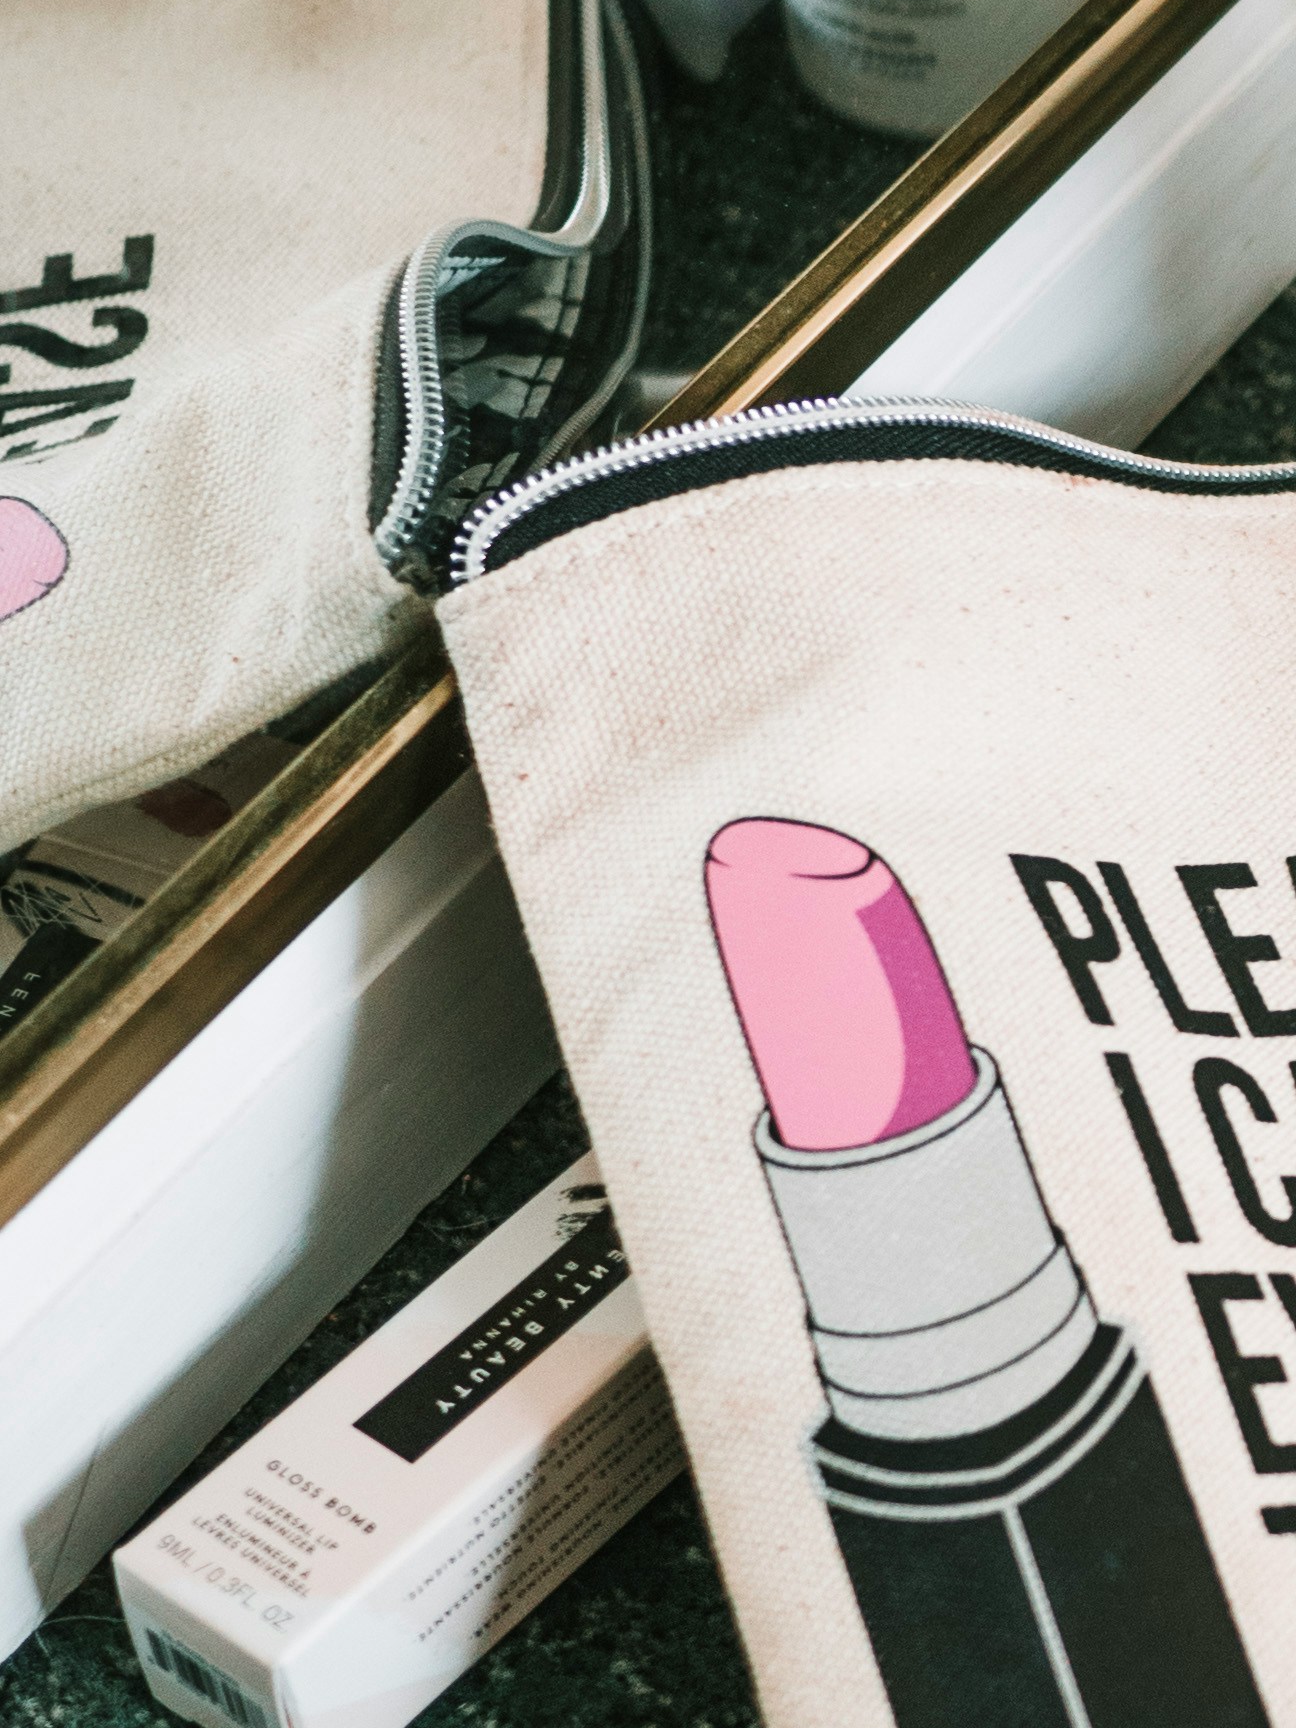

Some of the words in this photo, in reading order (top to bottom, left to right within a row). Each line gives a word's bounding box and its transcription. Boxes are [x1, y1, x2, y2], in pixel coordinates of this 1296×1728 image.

[1104, 1050, 1202, 1244] I
[553, 1260, 580, 1283] BY
[459, 1288, 547, 1360] RIHANNA
[435, 1320, 544, 1413] BEAUTY
[243, 1486, 314, 1536] UNIVERSAL
[314, 1532, 339, 1552] LIP
[264, 1458, 322, 1499] GLOSS
[323, 1496, 376, 1534] BOMB
[214, 1513, 298, 1570] ENLUMINEUR
[245, 1508, 315, 1554] LUMINIZER
[240, 1549, 309, 1598] UNIVERSEL
